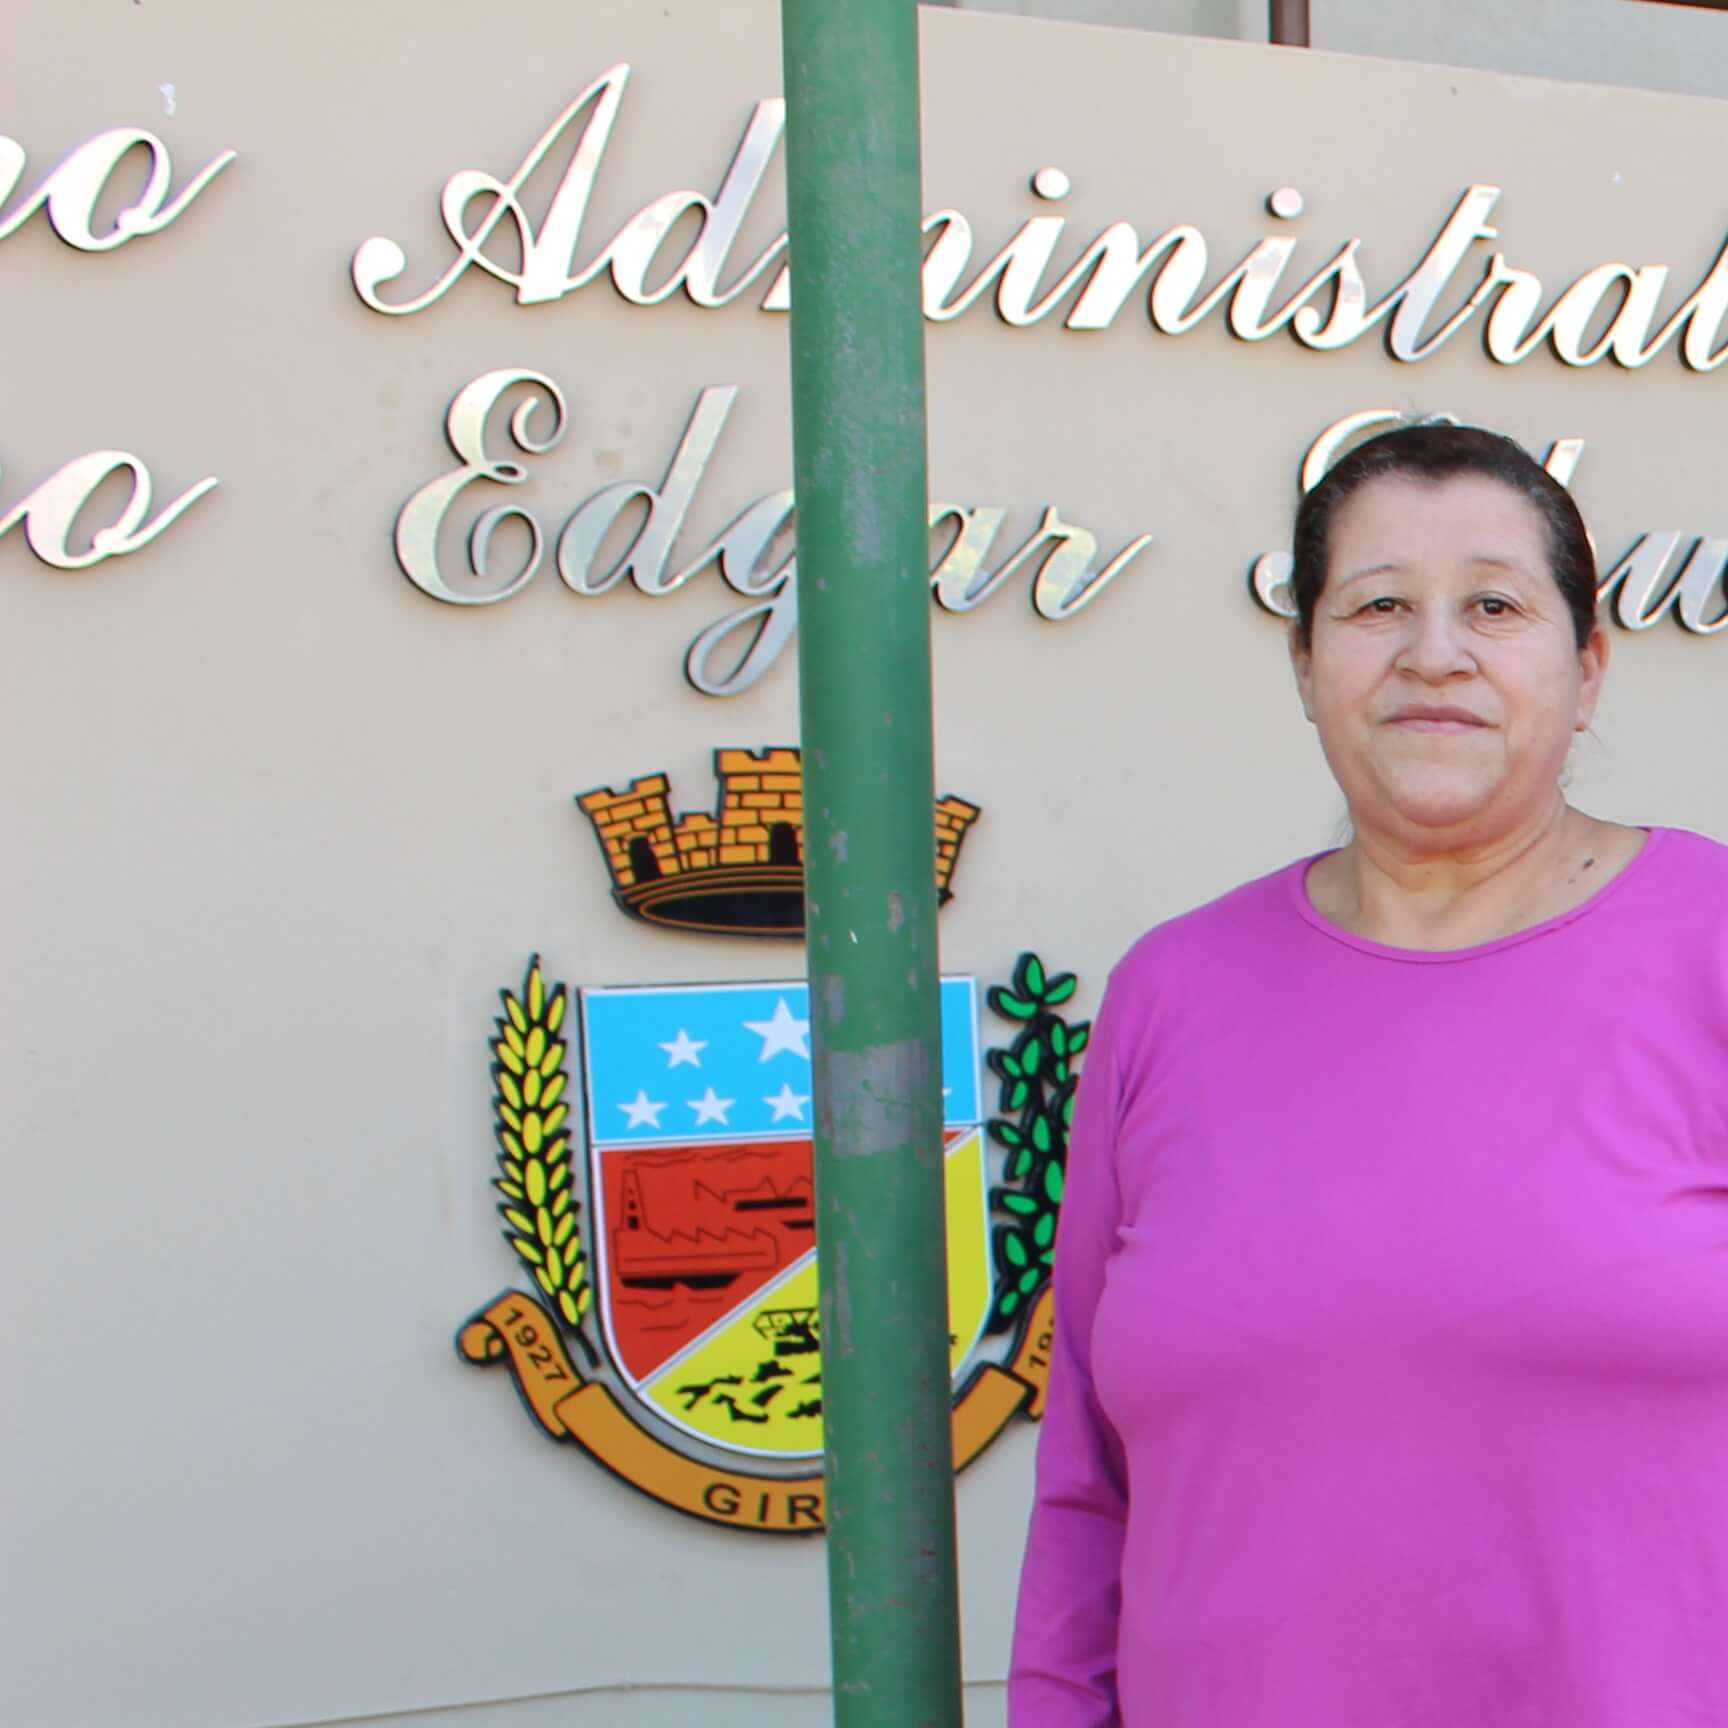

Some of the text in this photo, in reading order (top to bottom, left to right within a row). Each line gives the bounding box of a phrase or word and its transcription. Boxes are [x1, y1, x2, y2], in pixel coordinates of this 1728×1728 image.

[0, 127, 237, 252] o
[0, 449, 220, 569] o
[504, 1306, 569, 1381] 1927
[1028, 1314, 1054, 1368] 19
[703, 1482, 823, 1525] GIR
